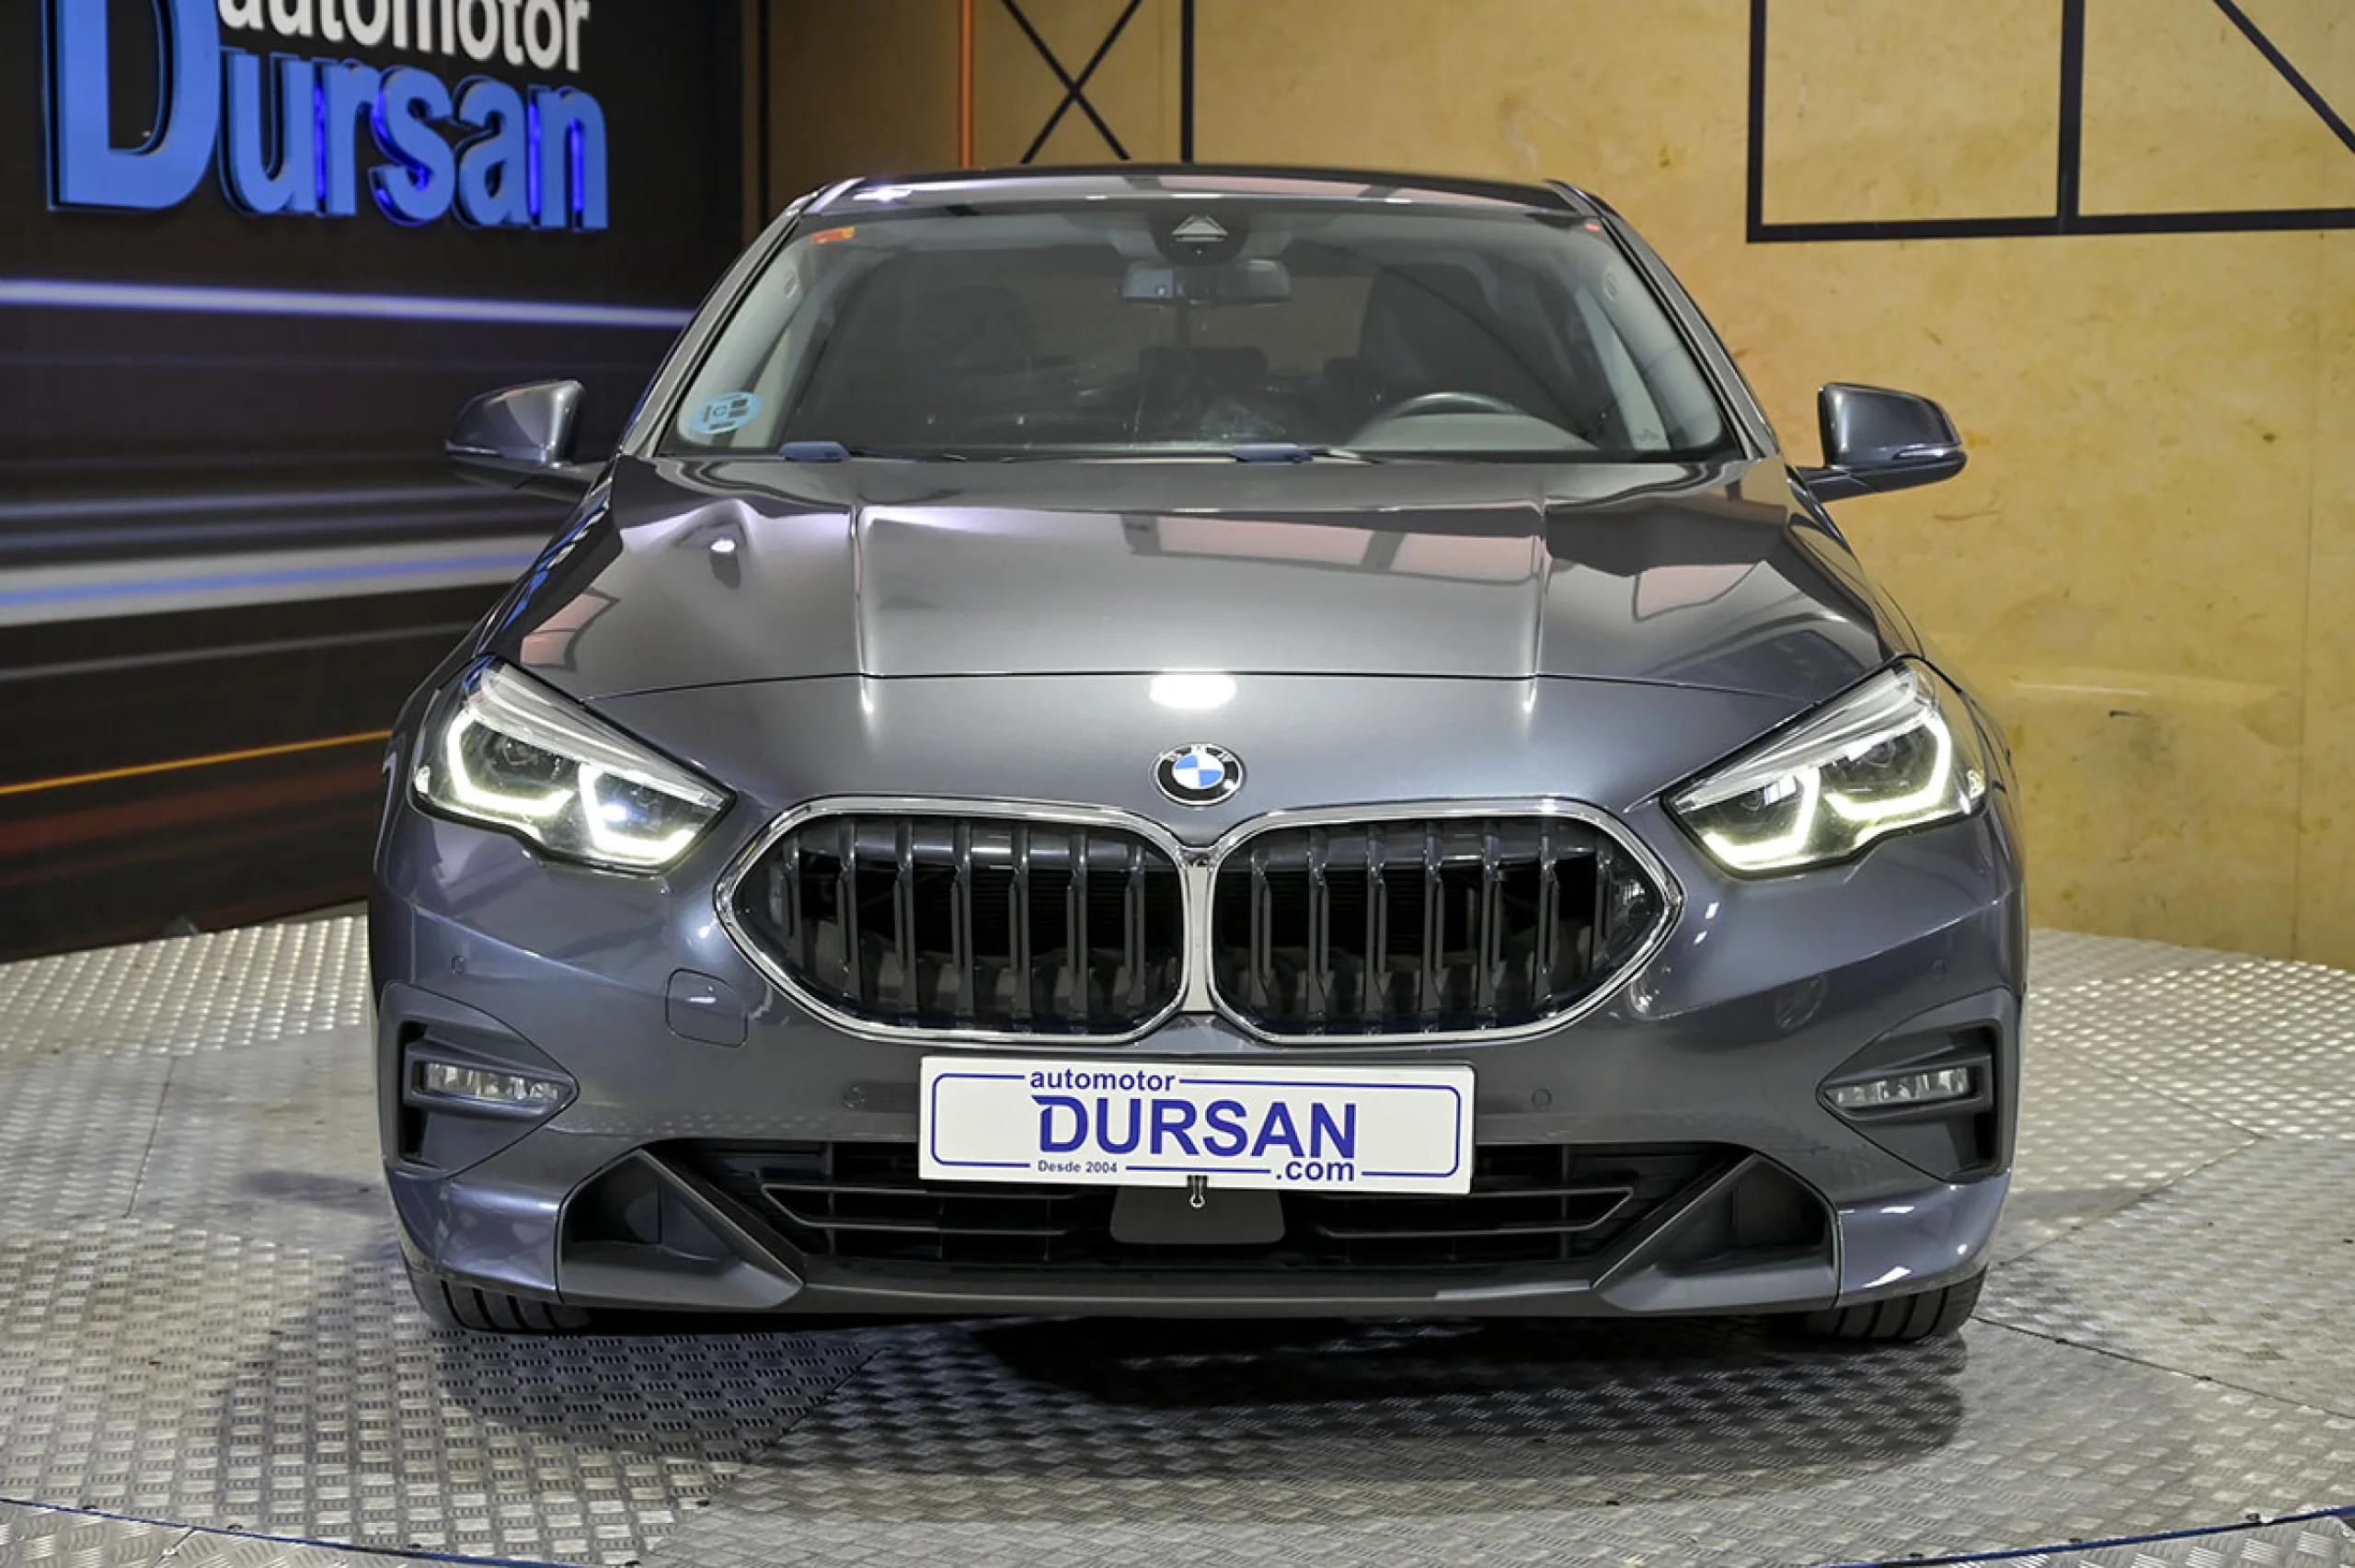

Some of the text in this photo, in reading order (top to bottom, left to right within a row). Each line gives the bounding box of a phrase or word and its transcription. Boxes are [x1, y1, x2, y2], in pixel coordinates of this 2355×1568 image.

[46, 0, 608, 230] Dursan
[1030, 1069, 1176, 1091] automotor
[1031, 1095, 1356, 1159] DURSAN
[1038, 1160, 1118, 1173] Desde 2004
[1276, 1162, 1355, 1182] .com
